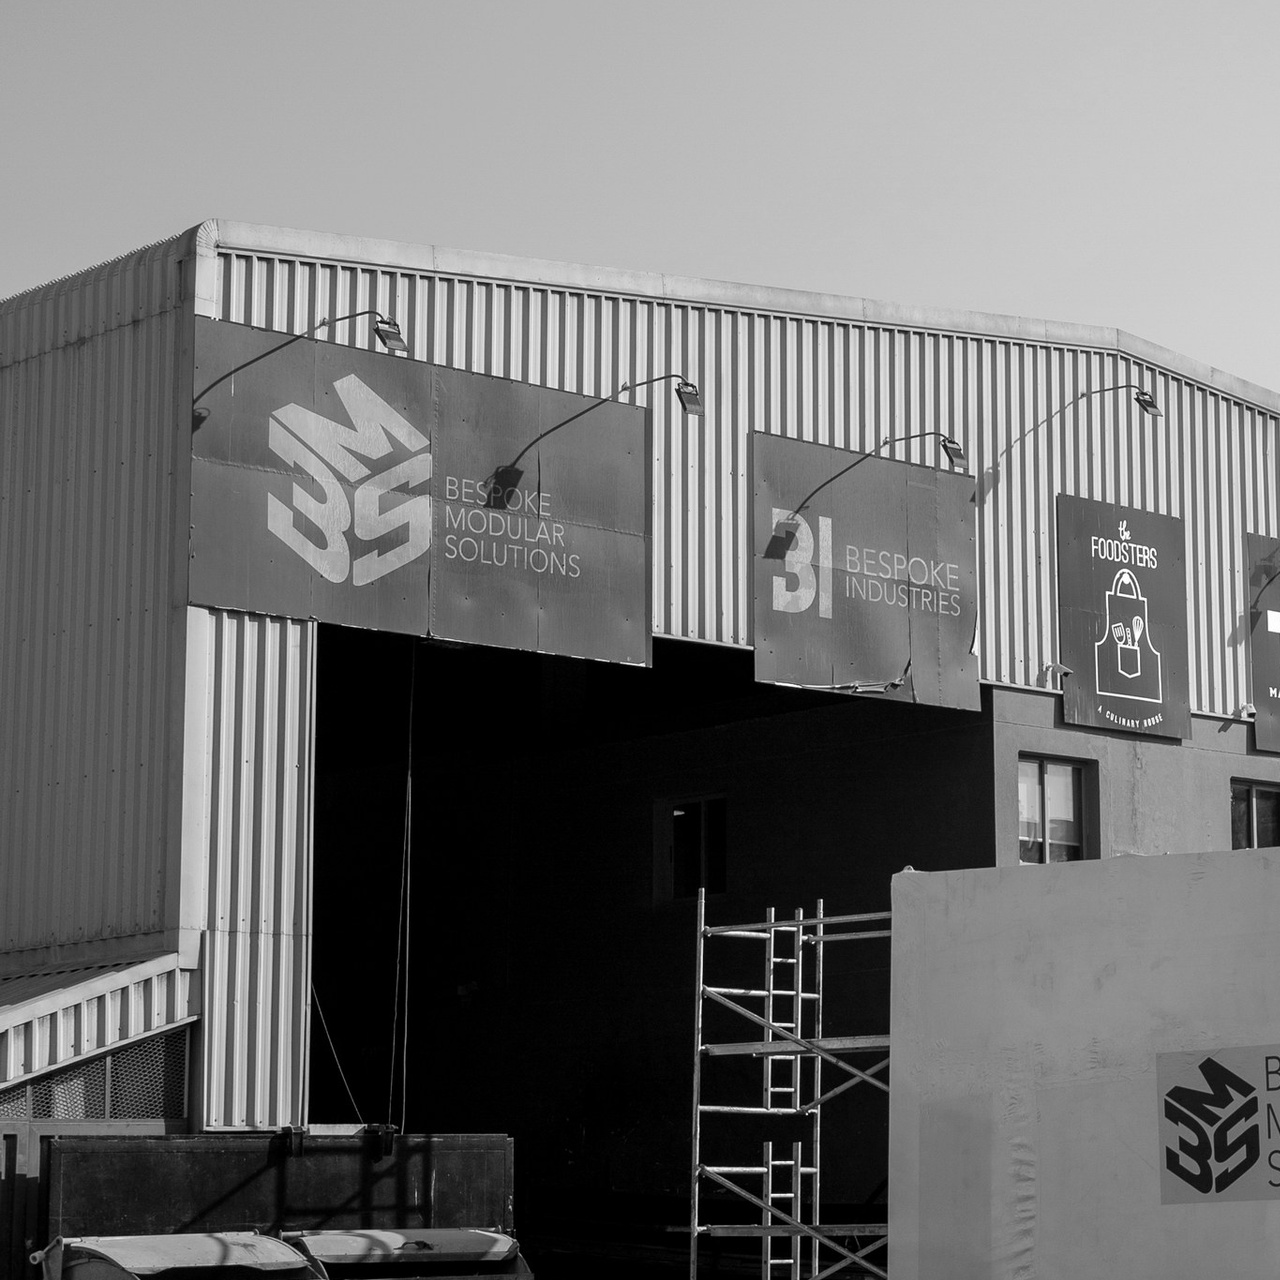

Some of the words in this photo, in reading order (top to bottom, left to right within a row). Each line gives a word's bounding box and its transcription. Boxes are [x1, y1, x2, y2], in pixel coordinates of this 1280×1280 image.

[446, 475, 551, 516] BESPOKE
[445, 505, 565, 547] MODULAR
[1118, 519, 1131, 541] the
[445, 534, 581, 578] SOLUTIONS
[846, 544, 960, 591] BESPOKE
[1091, 535, 1157, 569] FOODSTERS
[846, 575, 961, 617] INDUSTRIES
[1105, 710, 1140, 728] CULINARY
